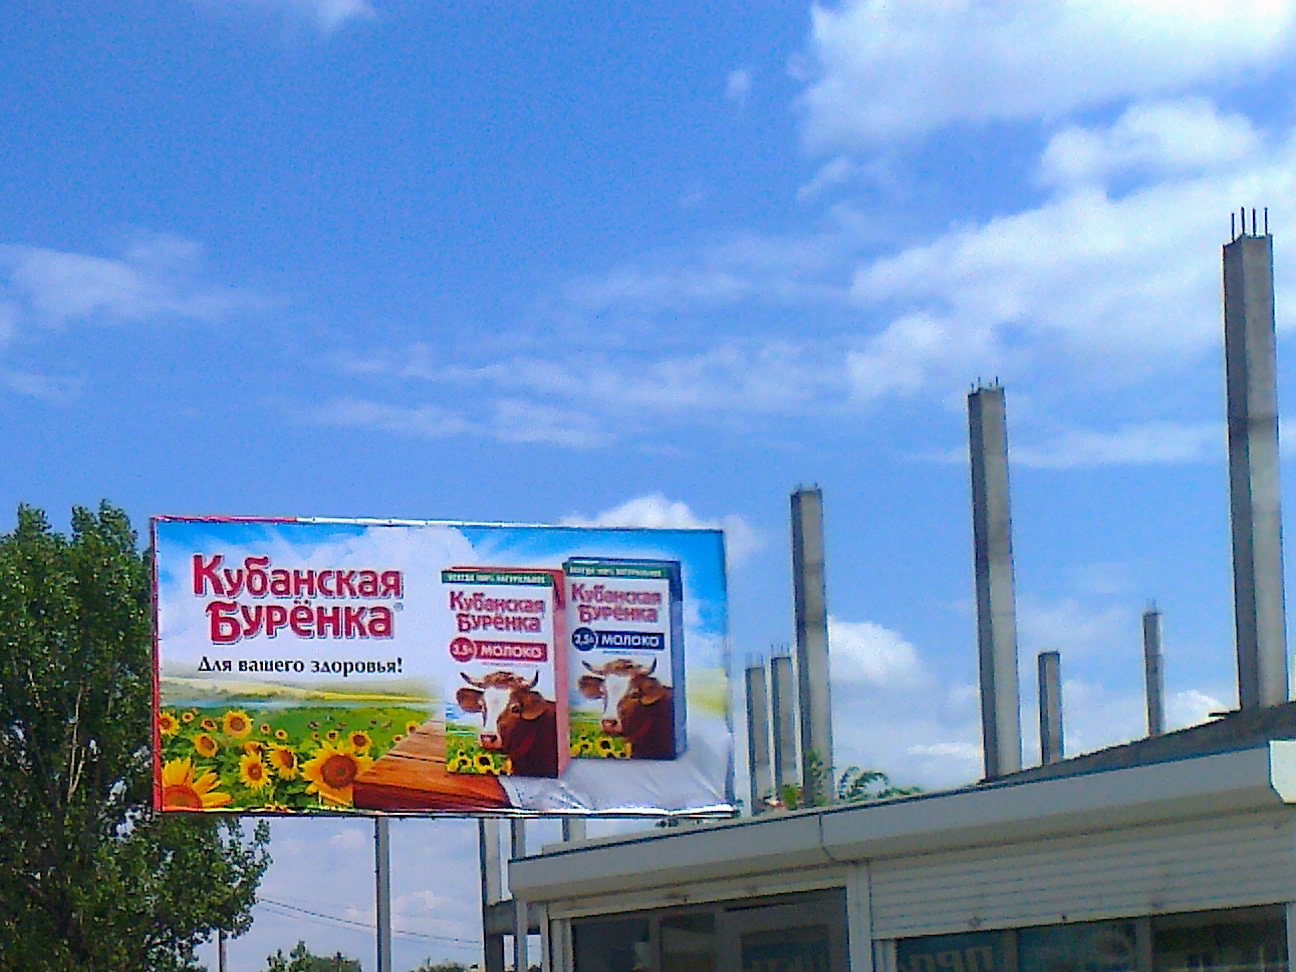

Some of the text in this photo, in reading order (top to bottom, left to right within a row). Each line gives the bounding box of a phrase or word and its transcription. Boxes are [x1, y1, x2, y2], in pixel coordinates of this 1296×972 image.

[191, 553, 404, 599] Кубанская
[449, 590, 545, 614] Кубанская
[570, 583, 662, 605] Кубанская
[205, 600, 395, 645] Бурёнка
[480, 645, 543, 659] МОЛОКО
[600, 634, 660, 648] МОЛОКО
[198, 656, 403, 677] Для вашего здоровья!
